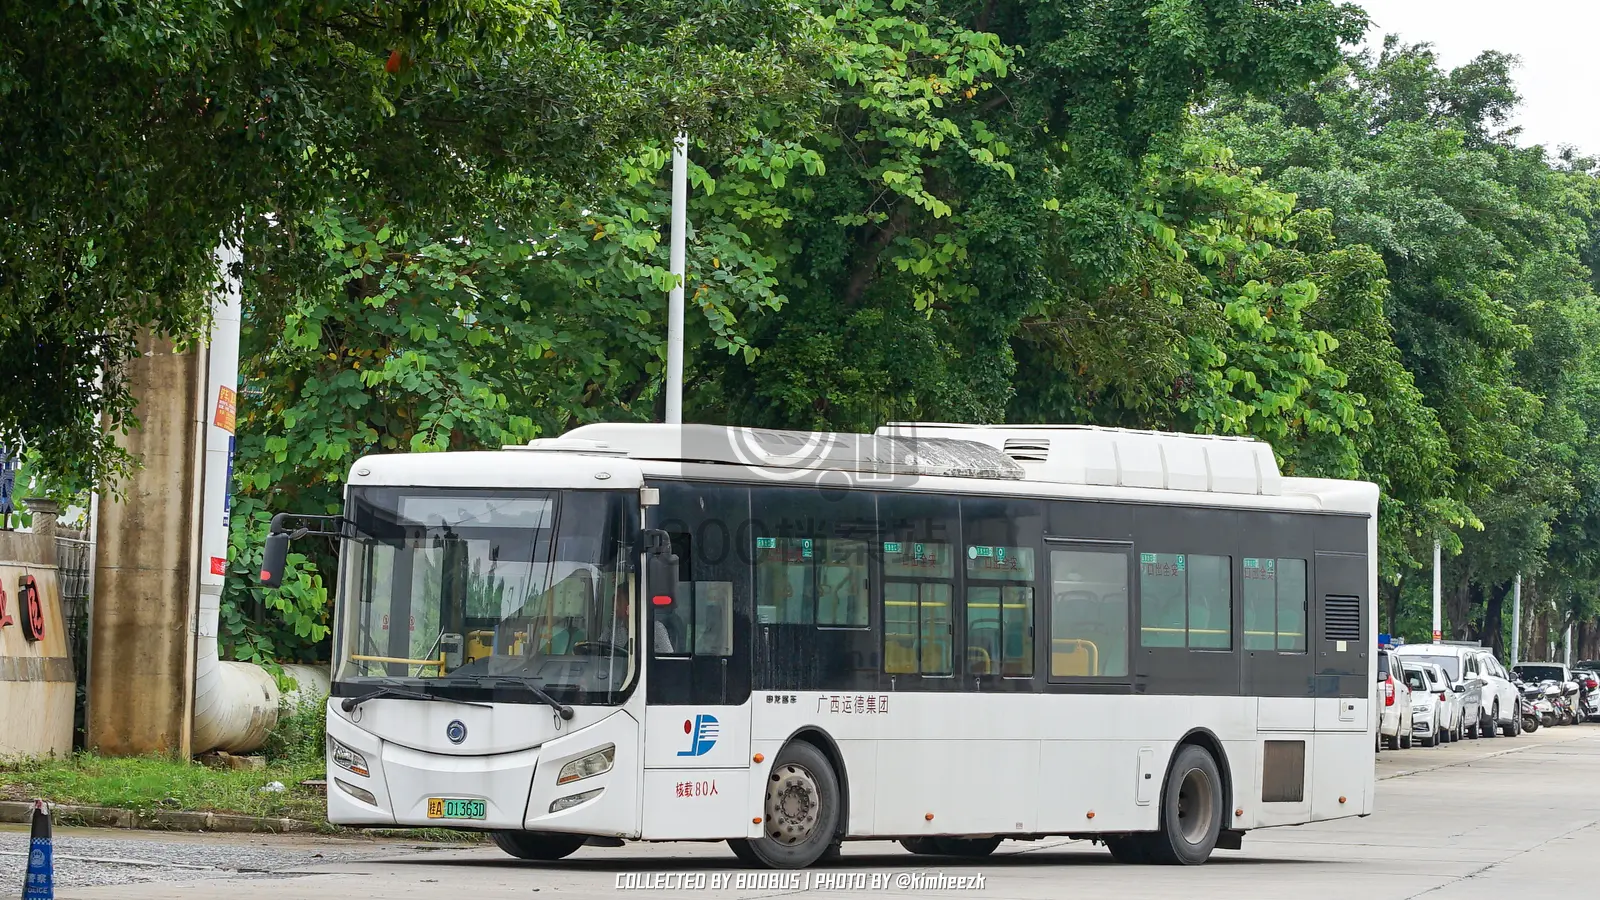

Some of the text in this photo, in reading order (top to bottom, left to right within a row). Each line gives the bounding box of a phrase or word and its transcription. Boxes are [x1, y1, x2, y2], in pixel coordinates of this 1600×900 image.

[817, 695, 889, 714] 广西运德集团
[675, 780, 719, 798] 核载80人
